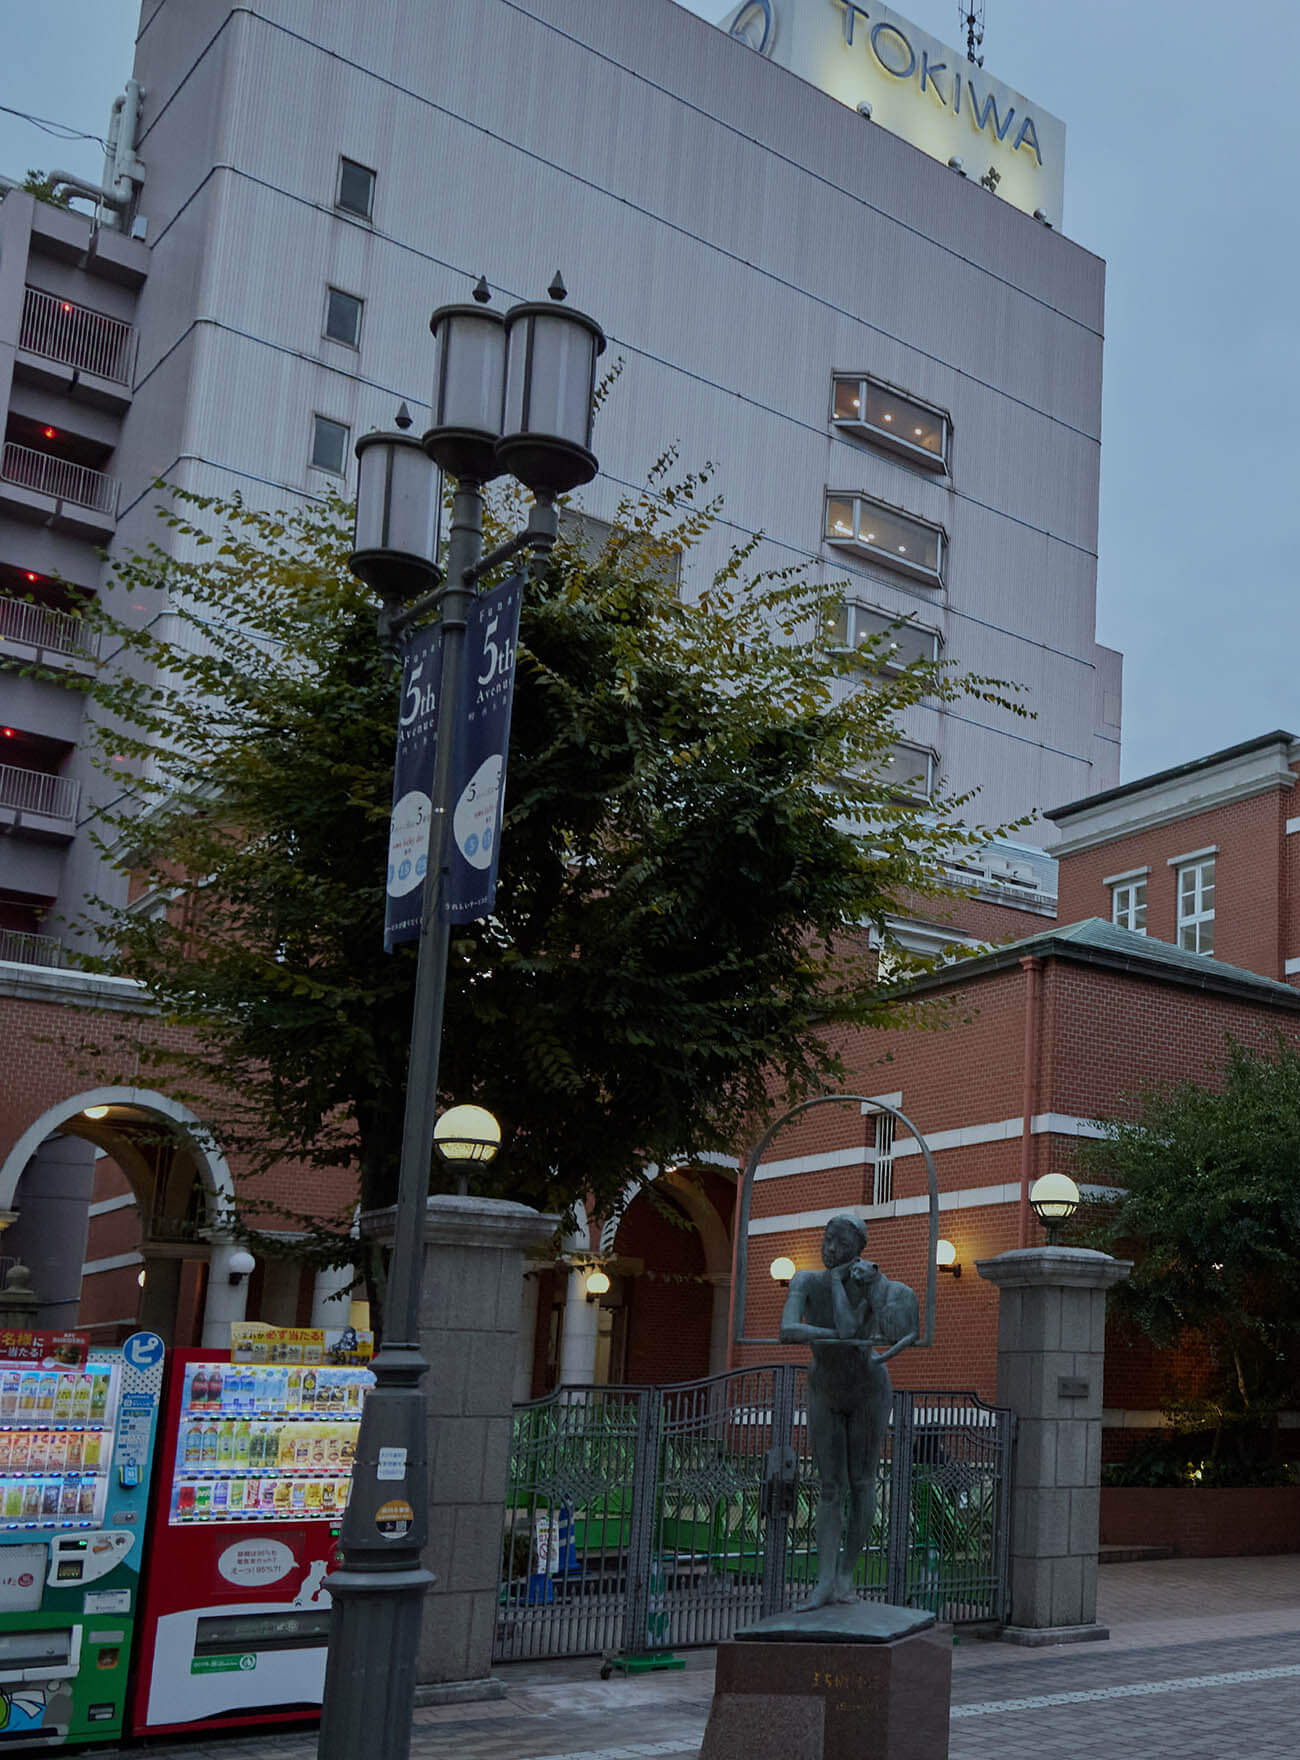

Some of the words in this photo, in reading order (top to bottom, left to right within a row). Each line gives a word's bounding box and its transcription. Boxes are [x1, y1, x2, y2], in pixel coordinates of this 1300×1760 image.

[834, 0, 1043, 166] TOKIWA
[477, 615, 514, 686] 5th
[400, 661, 437, 727] 5th
[130, 1336, 160, 1364] ピ
